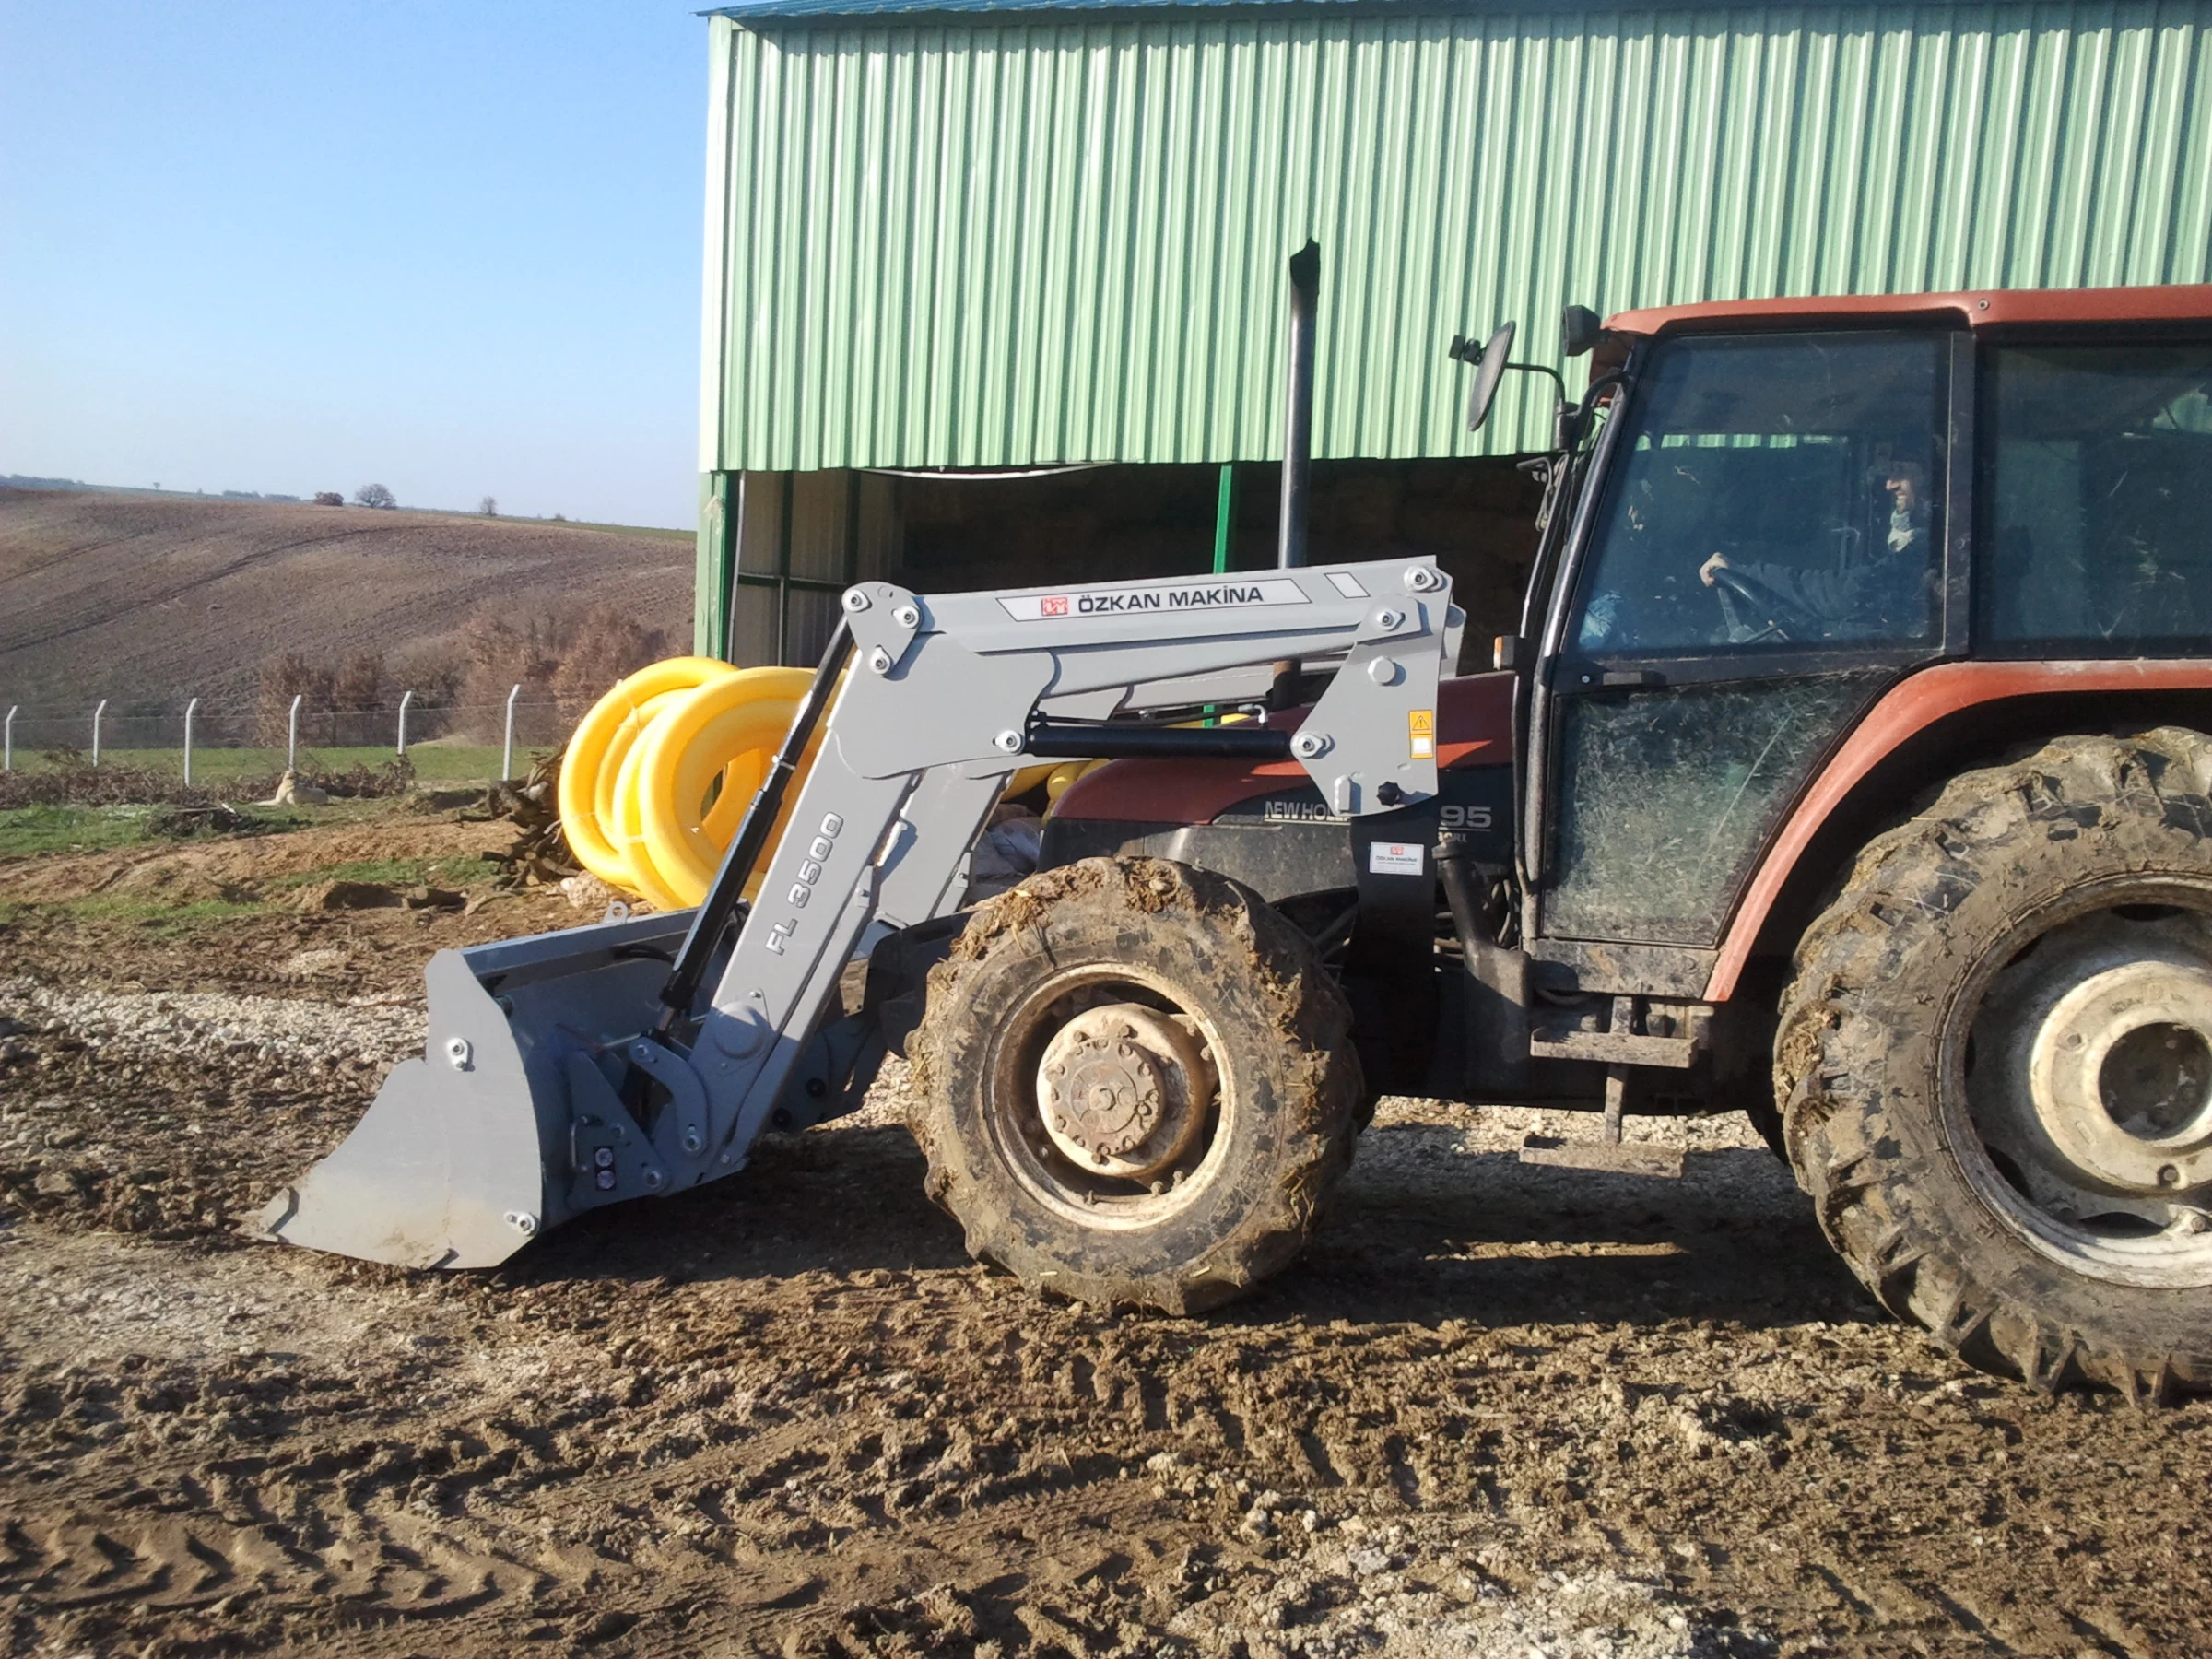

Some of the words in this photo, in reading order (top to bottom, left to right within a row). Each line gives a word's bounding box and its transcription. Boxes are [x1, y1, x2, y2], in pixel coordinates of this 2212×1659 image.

[1077, 593, 1161, 613] ÖZKAN
[1168, 585, 1265, 607] MAKİNA
[1264, 800, 1300, 819] NEW
[1440, 805, 1492, 828] 95
[765, 918, 798, 956] FL
[787, 811, 844, 909] 3500
